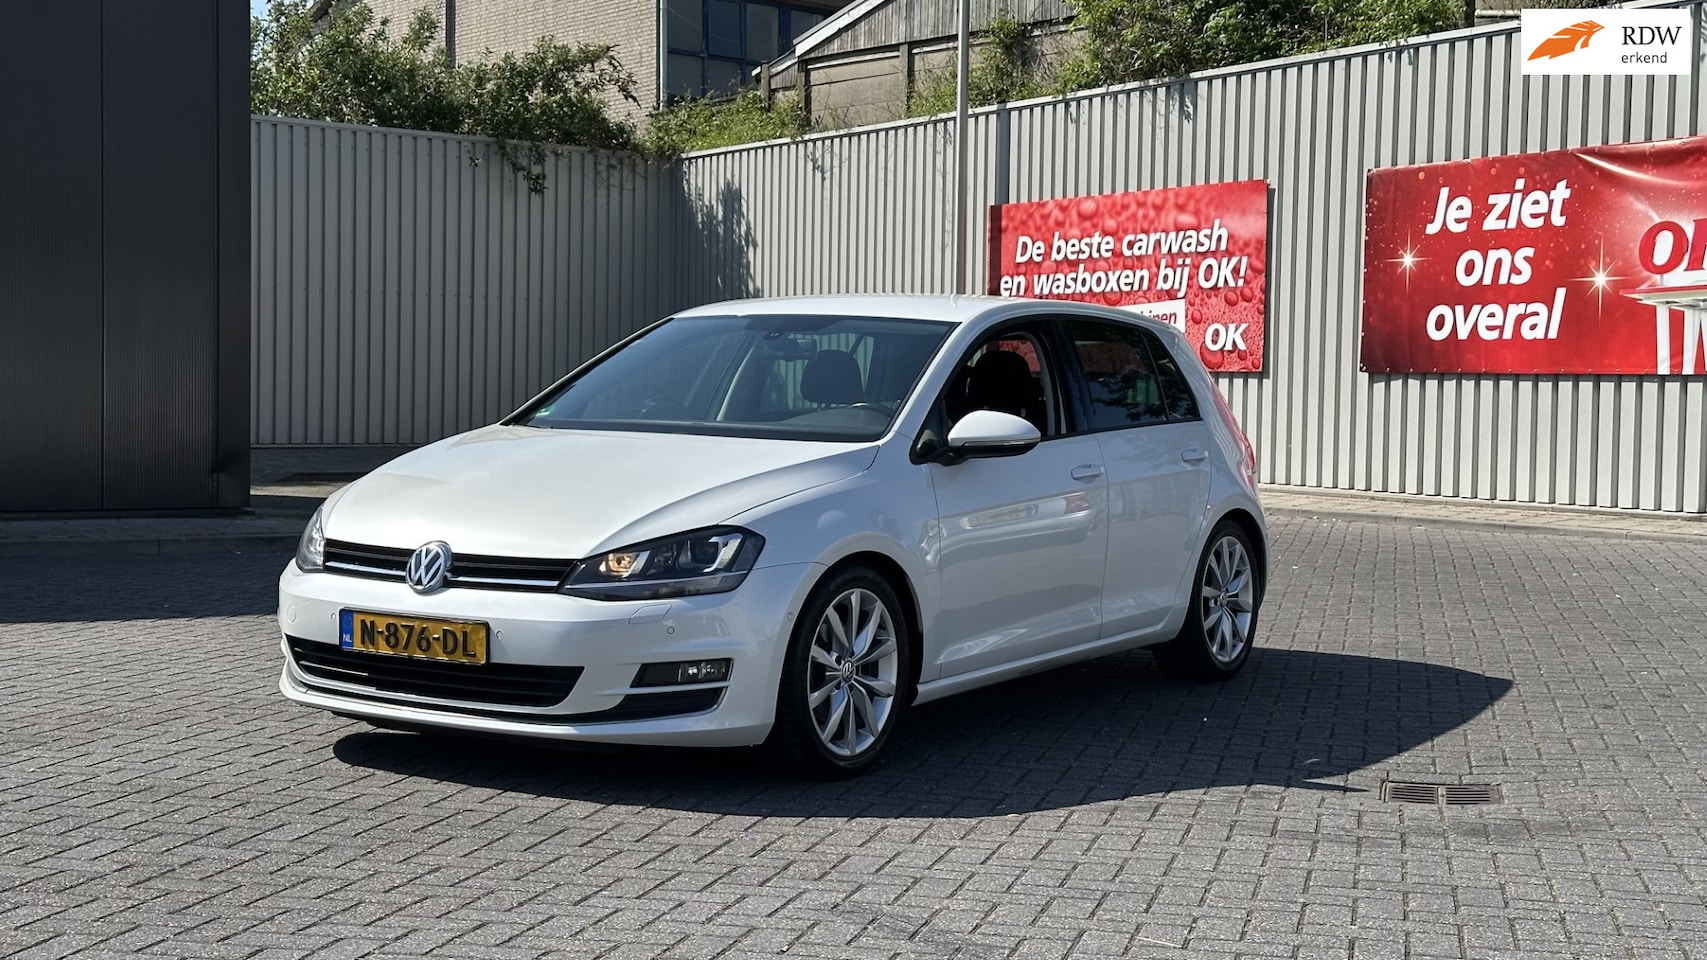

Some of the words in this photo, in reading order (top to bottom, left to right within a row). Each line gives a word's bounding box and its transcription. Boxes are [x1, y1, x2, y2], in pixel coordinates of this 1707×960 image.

[1425, 186, 1473, 235] Je
[1482, 178, 1571, 231] ziet
[1015, 235, 1045, 263] De
[1051, 231, 1114, 261] beste
[1121, 218, 1228, 257] carwash
[1000, 274, 1026, 297] en
[1033, 263, 1150, 296] wasboxen
[1157, 258, 1191, 298] bij
[1198, 256, 1248, 289] OK!
[1455, 246, 1535, 287] ons
[1426, 287, 1567, 341] overal
[1205, 323, 1250, 351] OK
[342, 632, 352, 643] NL
[360, 618, 477, 658] N-876-DL
